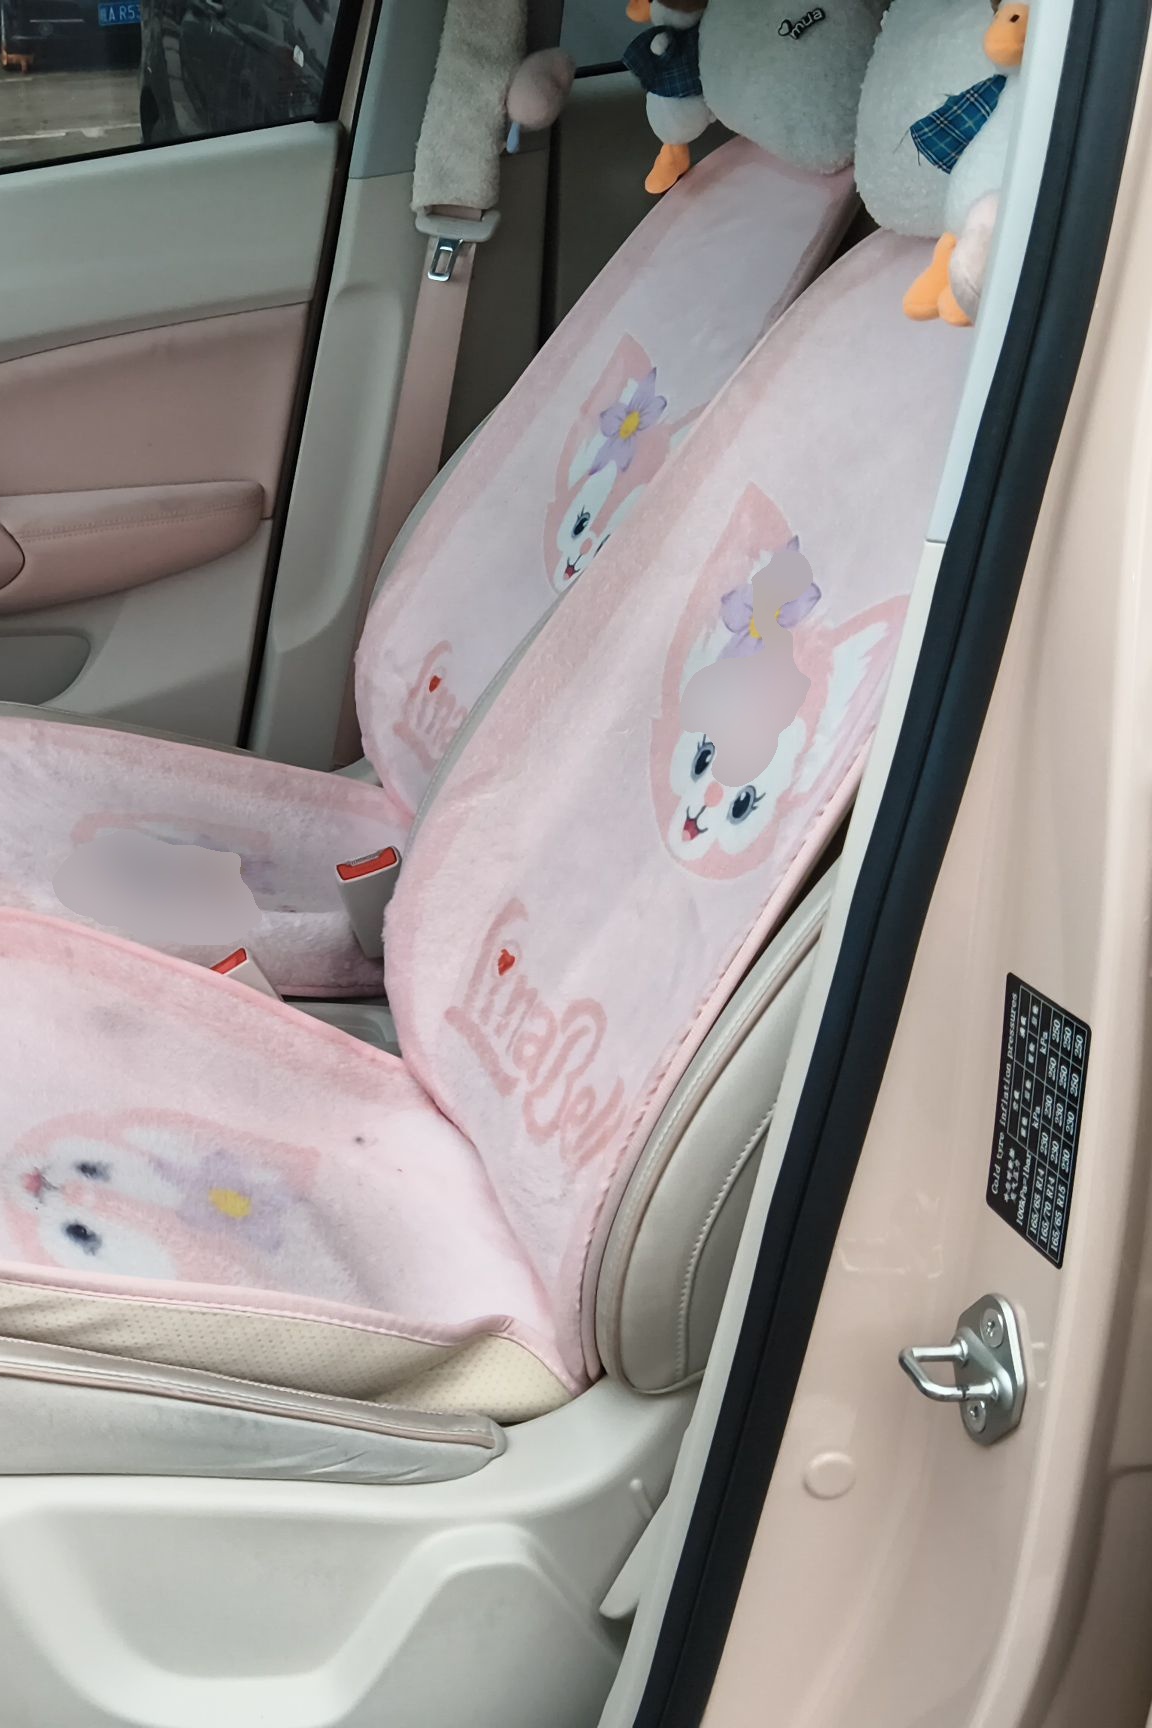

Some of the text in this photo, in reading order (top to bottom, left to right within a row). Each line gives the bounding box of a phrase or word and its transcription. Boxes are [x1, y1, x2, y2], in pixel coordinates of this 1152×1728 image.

[789, 8, 825, 40] mua
[1052, 1019, 1060, 1043] 250
[1040, 1032, 1048, 1054] kPa
[1075, 1035, 1083, 1058] 250
[1048, 1057, 1057, 1080] 250
[992, 1164, 1001, 1194] Cold
[1000, 1063, 1011, 1126] inflation
[1007, 993, 1017, 1059] pressures
[1070, 1073, 1079, 1097] 250
[1032, 1106, 1040, 1129] kPa
[1044, 1095, 1053, 1118] 230
[1046, 1177, 1055, 1199] R14
[1051, 1141, 1059, 1164] 230
[1055, 1103, 1063, 1126] 230
[1059, 1065, 1067, 1089] 250
[1063, 1027, 1072, 1050] 250
[1066, 1111, 1075, 1135] 230
[1040, 1132, 1048, 1155] 230
[1061, 1149, 1070, 1172] 230
[1035, 1168, 1044, 1190] R14
[1057, 1185, 1066, 1208] R15
